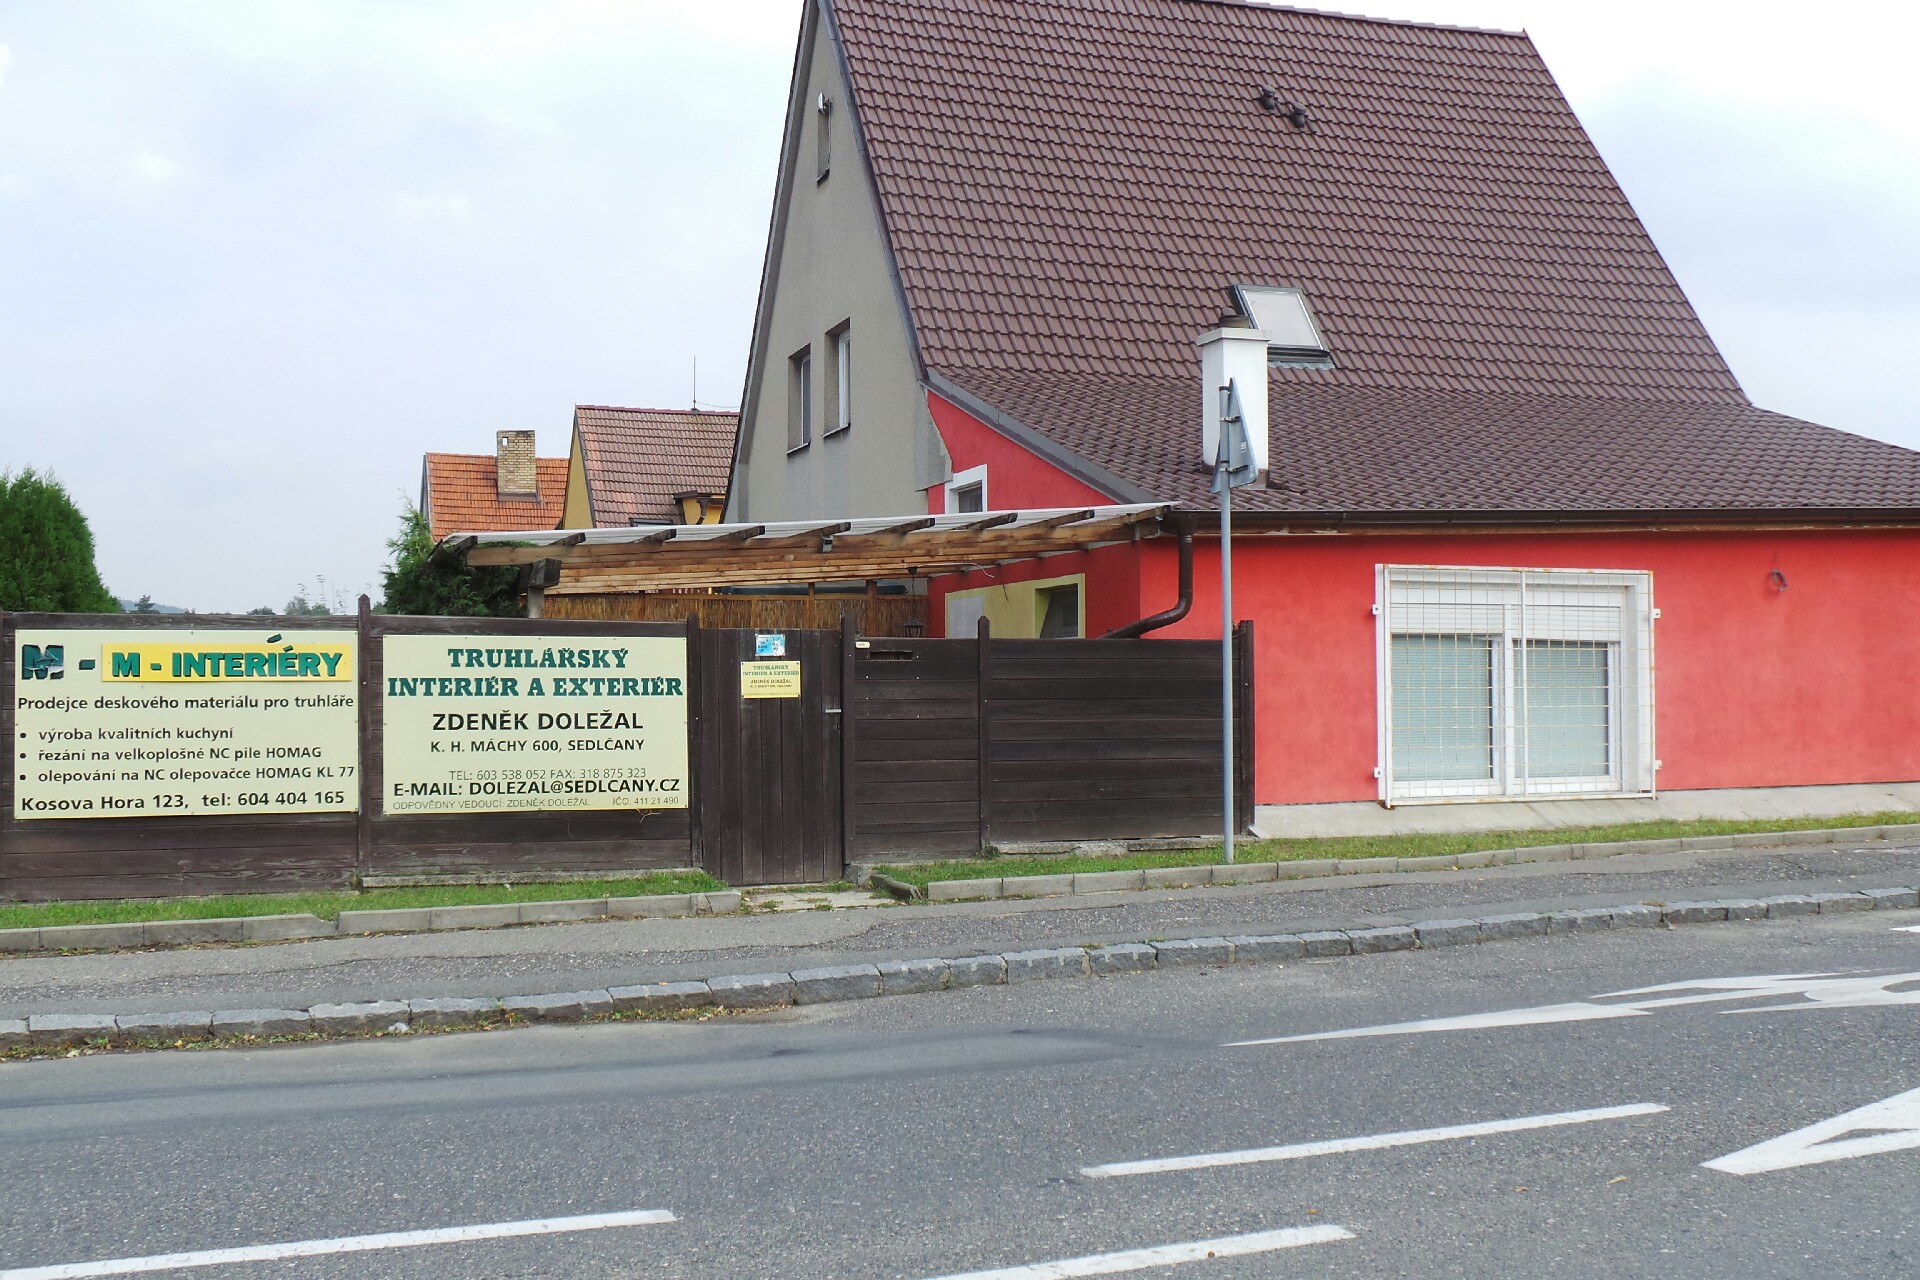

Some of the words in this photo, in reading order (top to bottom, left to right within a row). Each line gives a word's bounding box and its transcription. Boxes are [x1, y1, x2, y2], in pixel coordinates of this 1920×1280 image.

[112, 652, 140, 677] M
[172, 645, 343, 677] INTERIÉRY
[447, 647, 629, 668] TRUHLÁŘSKÝ
[387, 676, 519, 696] INTERIÉR
[527, 678, 545, 696] A
[552, 676, 684, 696] EXTERIÉR
[18, 696, 88, 713] Prodejce
[94, 695, 179, 709] deskového
[184, 695, 259, 709] materiálu
[264, 698, 289, 711] pro
[295, 694, 354, 708] truhláře
[432, 709, 529, 731] ZDENĚK
[538, 709, 644, 730] DOLEŽAL
[38, 728, 93, 743] výroba
[98, 728, 171, 740] kvalitních
[176, 727, 234, 742] kuchyní
[38, 749, 86, 761] řezání
[91, 752, 110, 761] na
[115, 748, 205, 763] velkoplošné
[209, 748, 230, 759] NC
[234, 747, 261, 762] pile
[266, 747, 322, 758] HOMAG
[430, 741, 445, 753] K.
[450, 741, 465, 752] H.
[470, 738, 527, 752] MÁCHY
[532, 740, 562, 753] 600,
[567, 738, 645, 751] SEDLČANY
[38, 769, 116, 785] olepování
[121, 771, 139, 781] na
[144, 769, 165, 781] NC
[169, 767, 251, 782] olepovačce
[256, 767, 312, 779] HOMAG
[316, 766, 334, 778] KL
[338, 766, 355, 777] 77
[449, 770, 473, 780] TEL:
[476, 770, 497, 780] 603
[501, 769, 522, 780] 538
[525, 769, 546, 780] 052
[550, 769, 576, 779] FAX:
[579, 768, 600, 779] 318
[603, 768, 624, 778] 875
[627, 768, 647, 778] 323
[393, 782, 462, 796] E-MAIL:
[469, 779, 680, 795] DOLEZAL@SEDLCANY.CZ
[21, 797, 93, 811] Kosova
[101, 796, 145, 809] Hora
[152, 794, 189, 809] 123,
[202, 793, 231, 807] tel:
[237, 792, 270, 806] 604
[275, 791, 308, 805] 404
[314, 791, 345, 804] 165
[393, 799, 456, 810] ODPOVĚDNÝ
[506, 798, 545, 808] ZDENĚK
[547, 797, 591, 807] DOLEŽAL
[633, 797, 649, 805] 411
[650, 797, 661, 805] 21
[663, 796, 679, 805] 490
